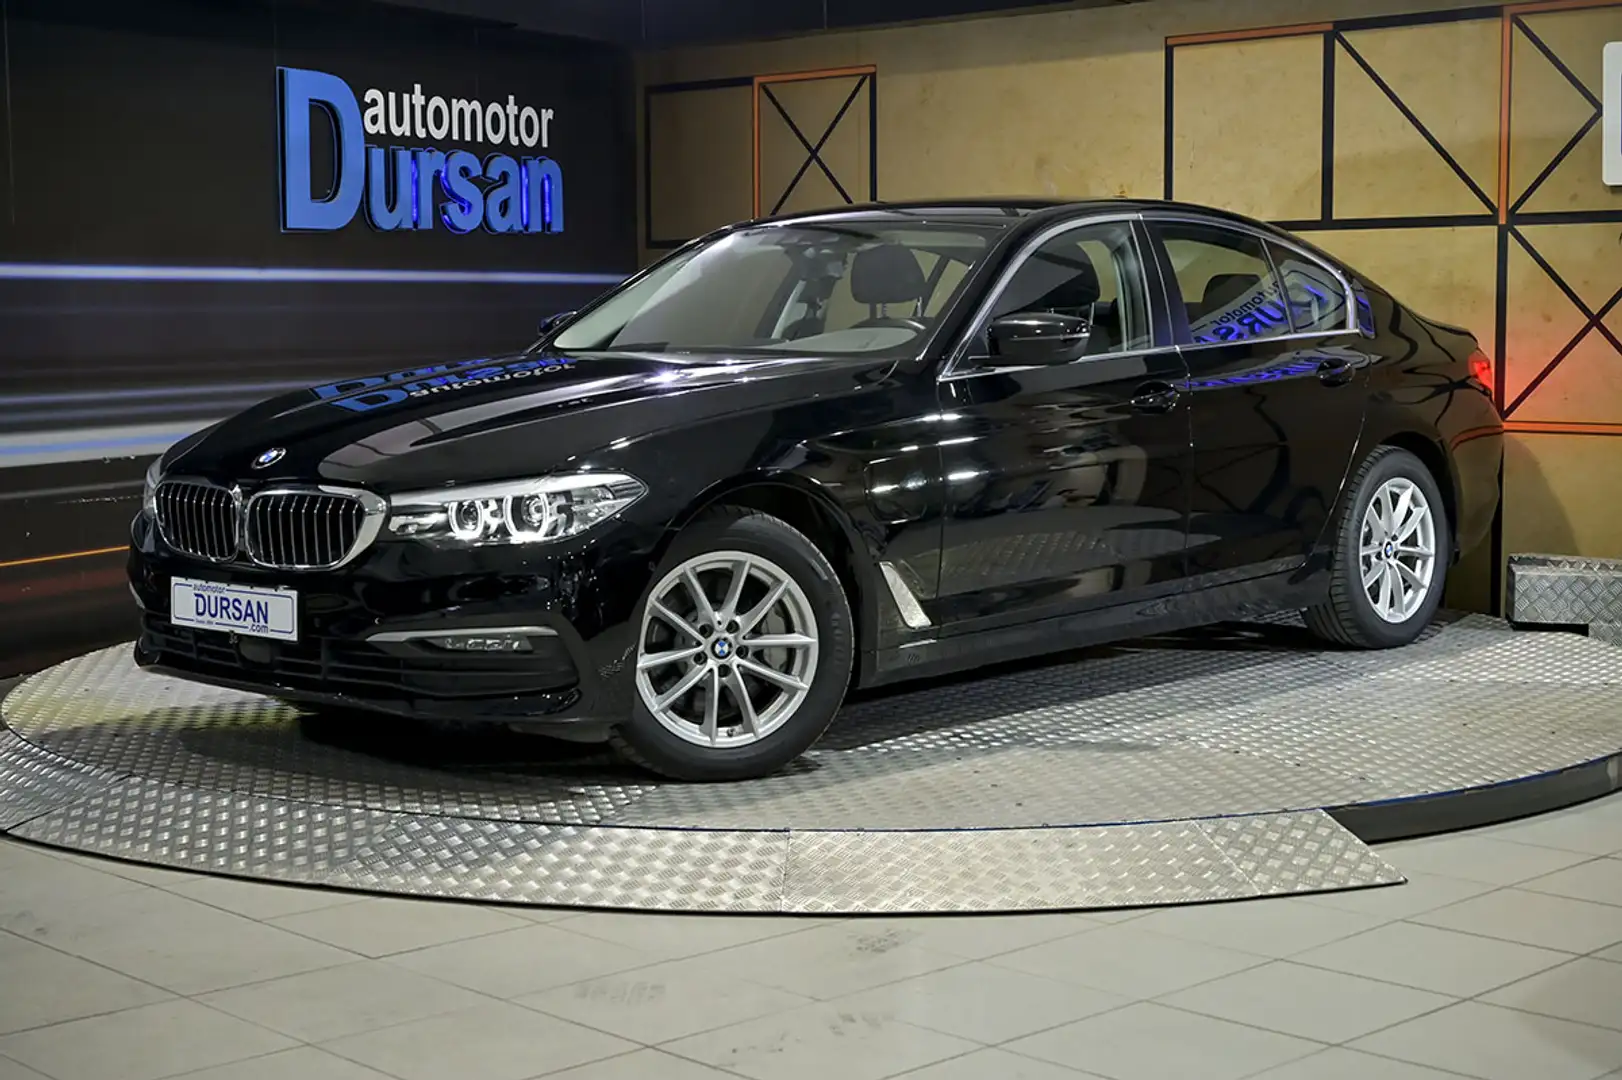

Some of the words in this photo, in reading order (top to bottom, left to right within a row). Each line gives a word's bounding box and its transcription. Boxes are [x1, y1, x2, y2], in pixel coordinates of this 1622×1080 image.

[363, 83, 554, 147] automotor
[276, 66, 564, 234] Dursan
[193, 583, 226, 594] automotor
[193, 593, 269, 625] DURSAN
[249, 623, 269, 635] .com
